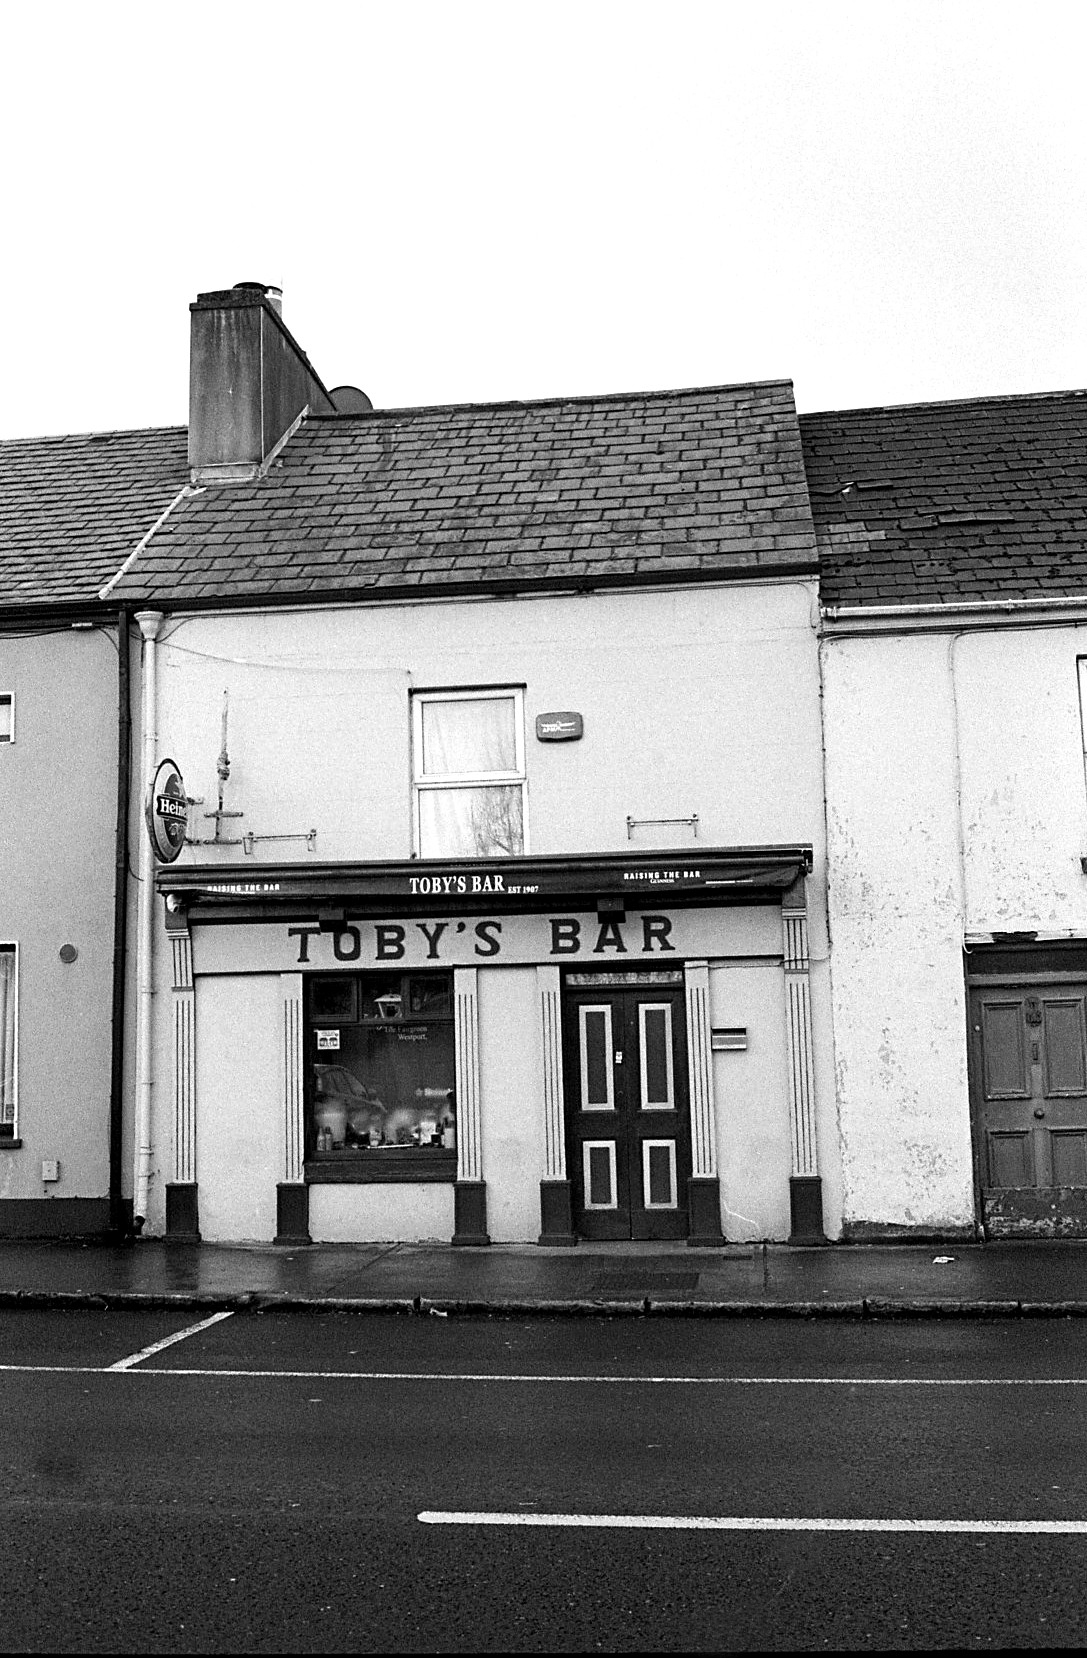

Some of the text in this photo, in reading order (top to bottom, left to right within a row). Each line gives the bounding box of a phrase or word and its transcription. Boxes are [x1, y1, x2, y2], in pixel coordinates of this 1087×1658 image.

[623, 870, 701, 880] RAISING THE BAR
[207, 884, 241, 893] RAISING
[245, 884, 260, 892] THE
[263, 883, 280, 891] BAR
[409, 874, 505, 894] TOBY'S BAR
[507, 885, 539, 894] EST 1907
[288, 915, 676, 963] TOBY'S BAR
